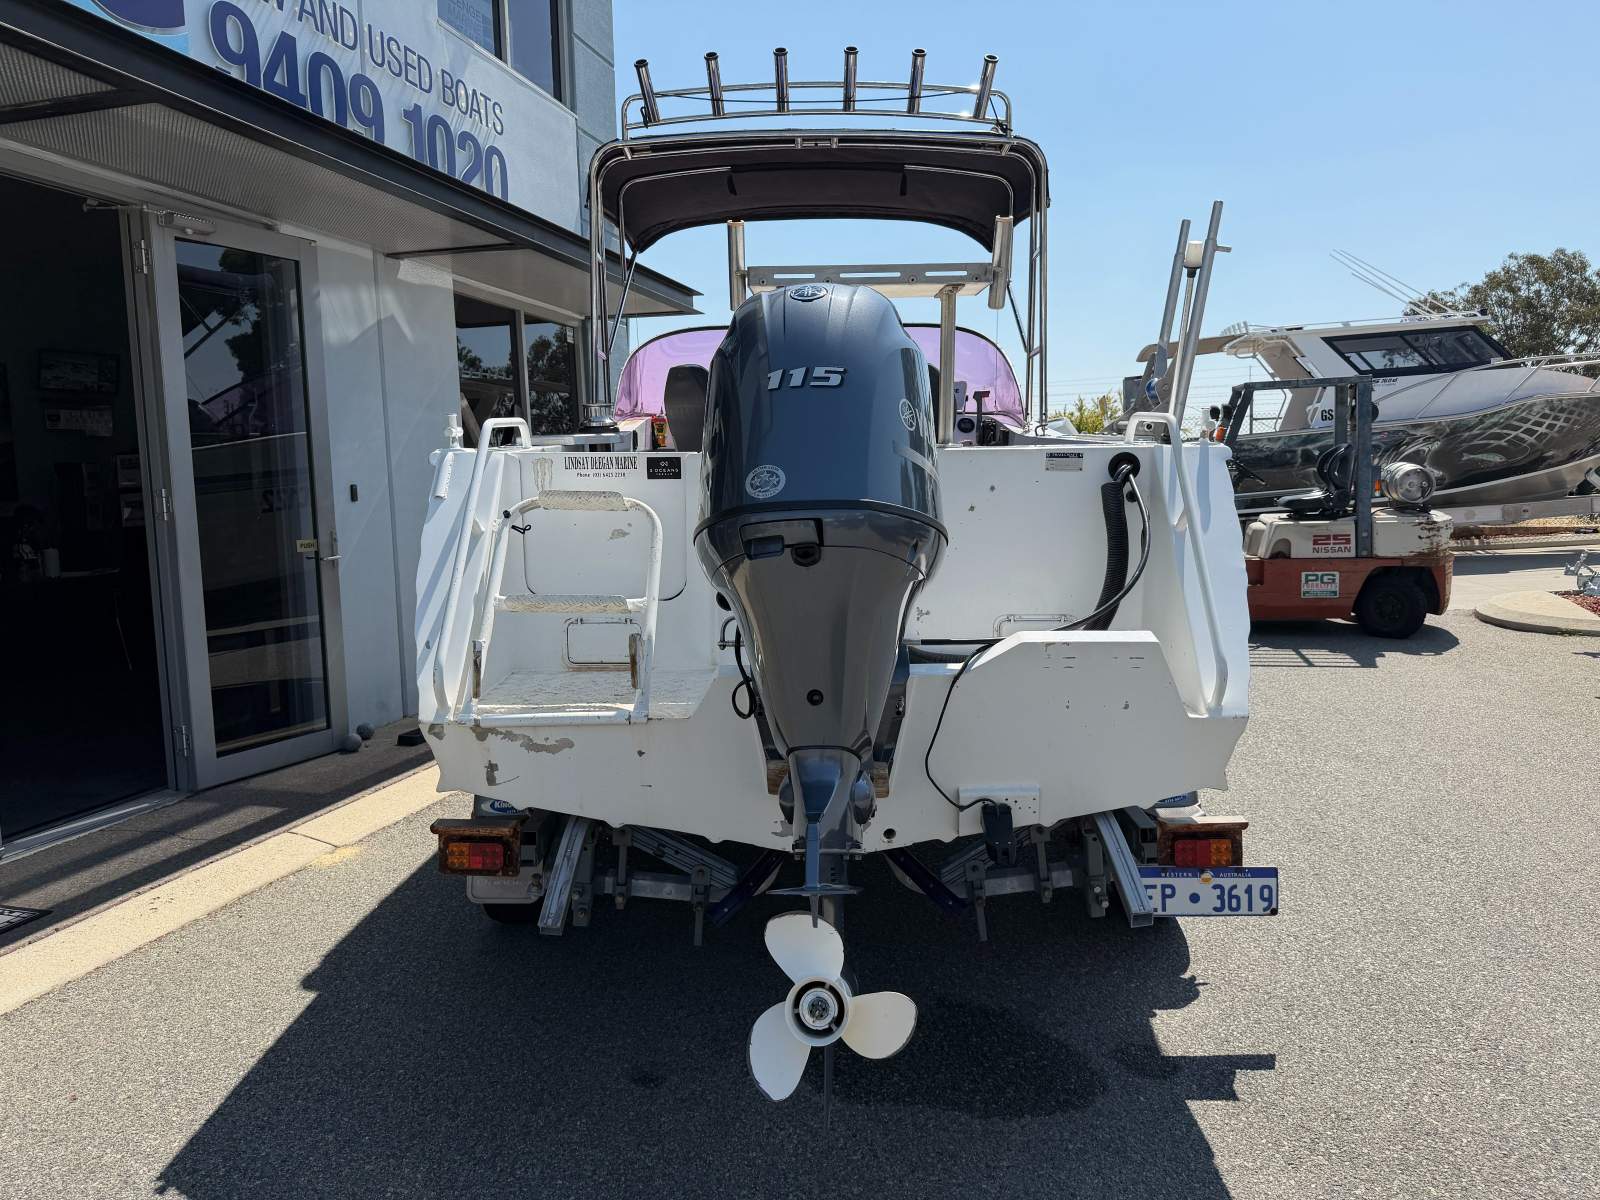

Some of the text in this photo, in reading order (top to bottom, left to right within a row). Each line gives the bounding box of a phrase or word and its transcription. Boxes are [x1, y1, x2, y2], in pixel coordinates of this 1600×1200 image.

[298, 0, 504, 136] AND USED BOATS
[210, 0, 509, 204] 9409 1020
[767, 366, 847, 390] 115
[1320, 408, 1334, 422] GS
[564, 456, 638, 470] LINDSAY DEEGAN MARINE
[1313, 534, 1351, 546] 25
[1312, 546, 1352, 554] NISSAN
[1304, 573, 1337, 584] PG
[1211, 884, 1273, 913] 3619
